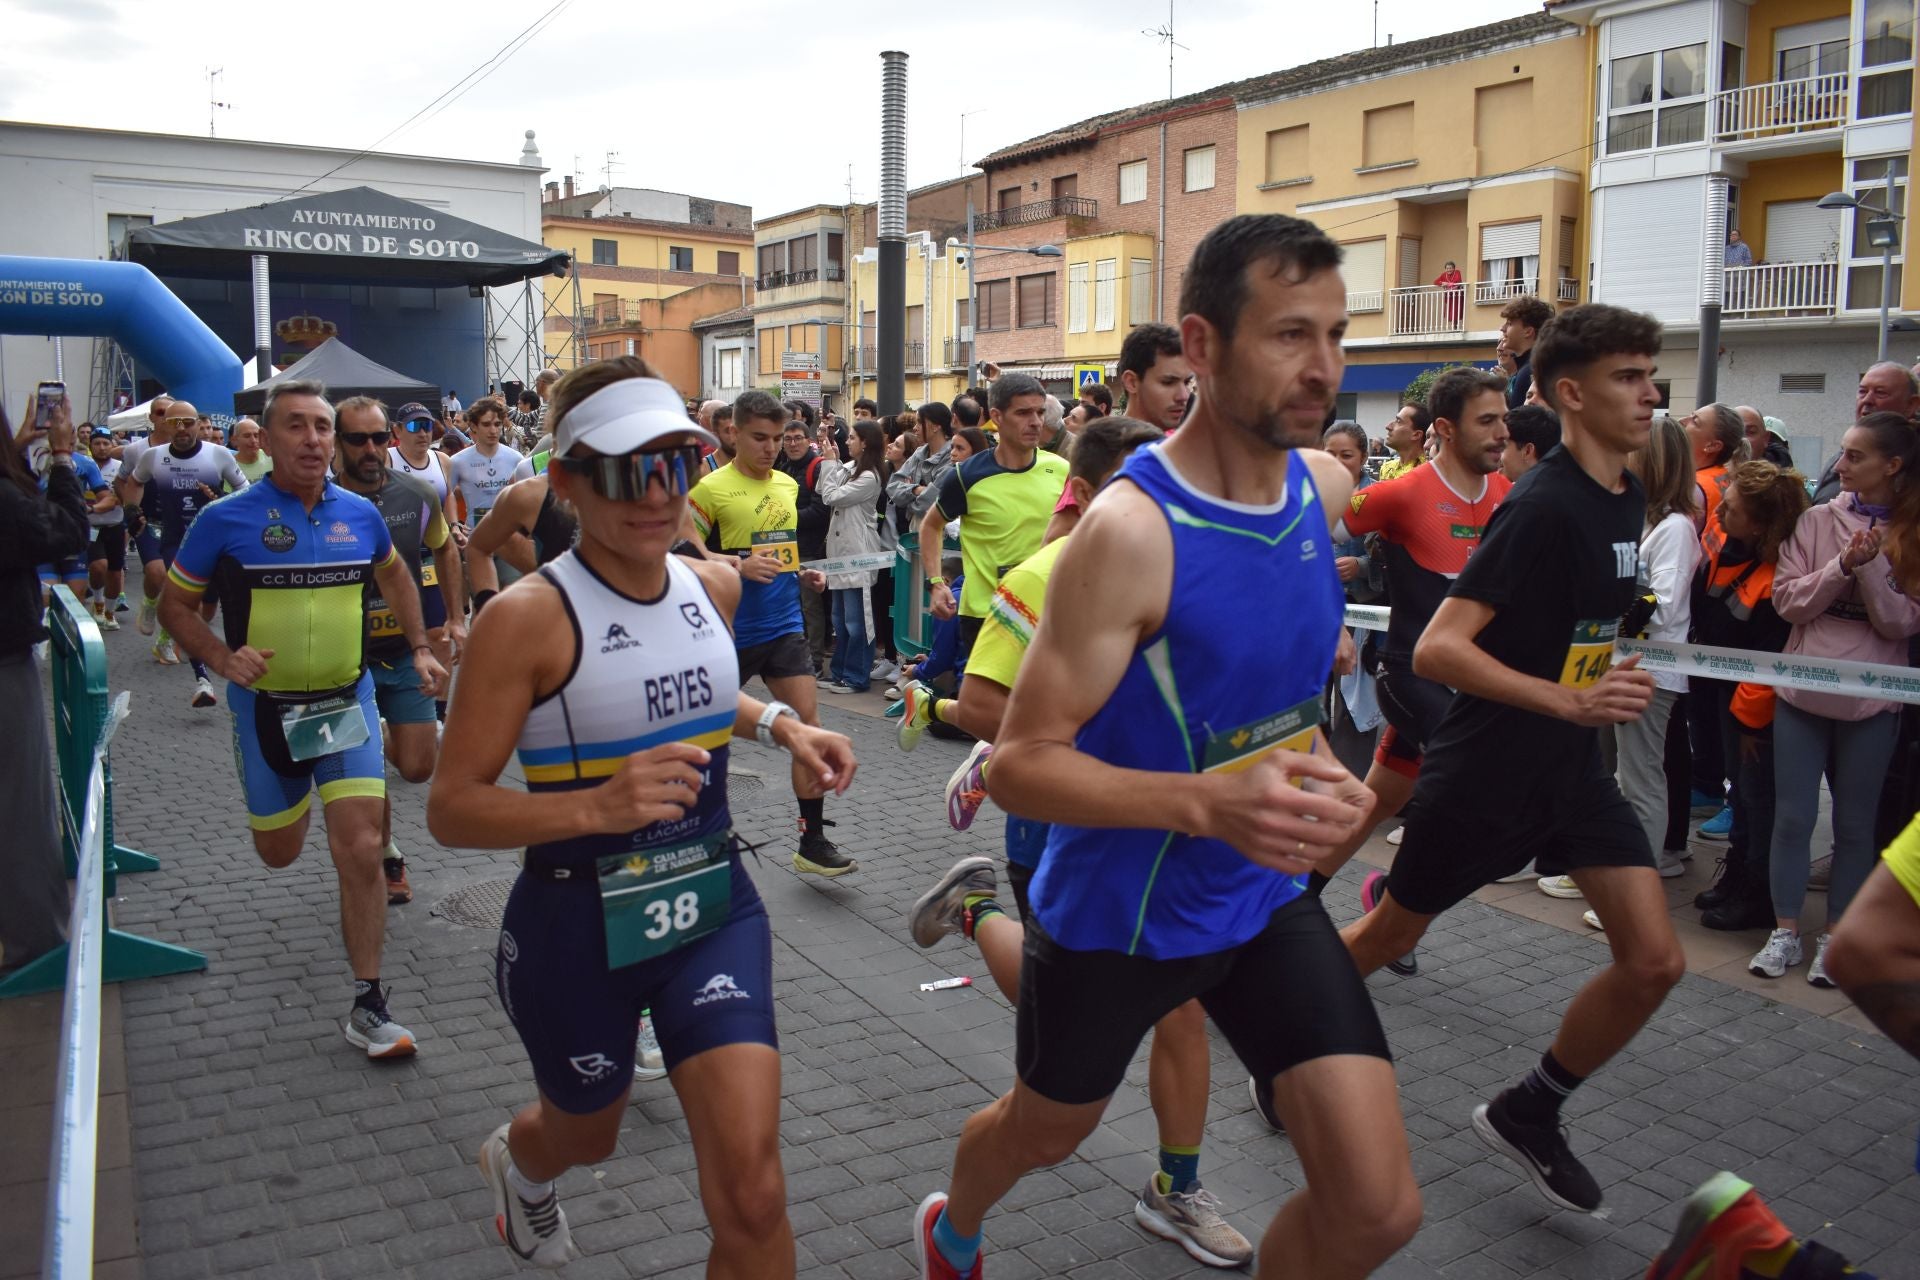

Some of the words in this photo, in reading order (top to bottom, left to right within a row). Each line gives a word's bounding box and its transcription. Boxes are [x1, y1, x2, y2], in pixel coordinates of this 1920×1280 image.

[291, 209, 436, 231] AYUNTAMIENTO
[243, 227, 352, 252] RINCON
[361, 235, 399, 255] DE
[408, 238, 480, 259] SOTO
[68, 282, 83, 291] DE
[31, 291, 54, 305] DE
[58, 292, 104, 306] SOTO
[291, 572, 303, 584] la
[307, 569, 361, 584] bascula
[1722, 664, 1756, 673] NAVARRA
[1791, 671, 1802, 679] DE
[1804, 672, 1841, 684] NAVARRA
[644, 665, 713, 723] REYES
[318, 722, 334, 744] 1
[654, 862, 669, 874] DE
[643, 890, 700, 940] 38
